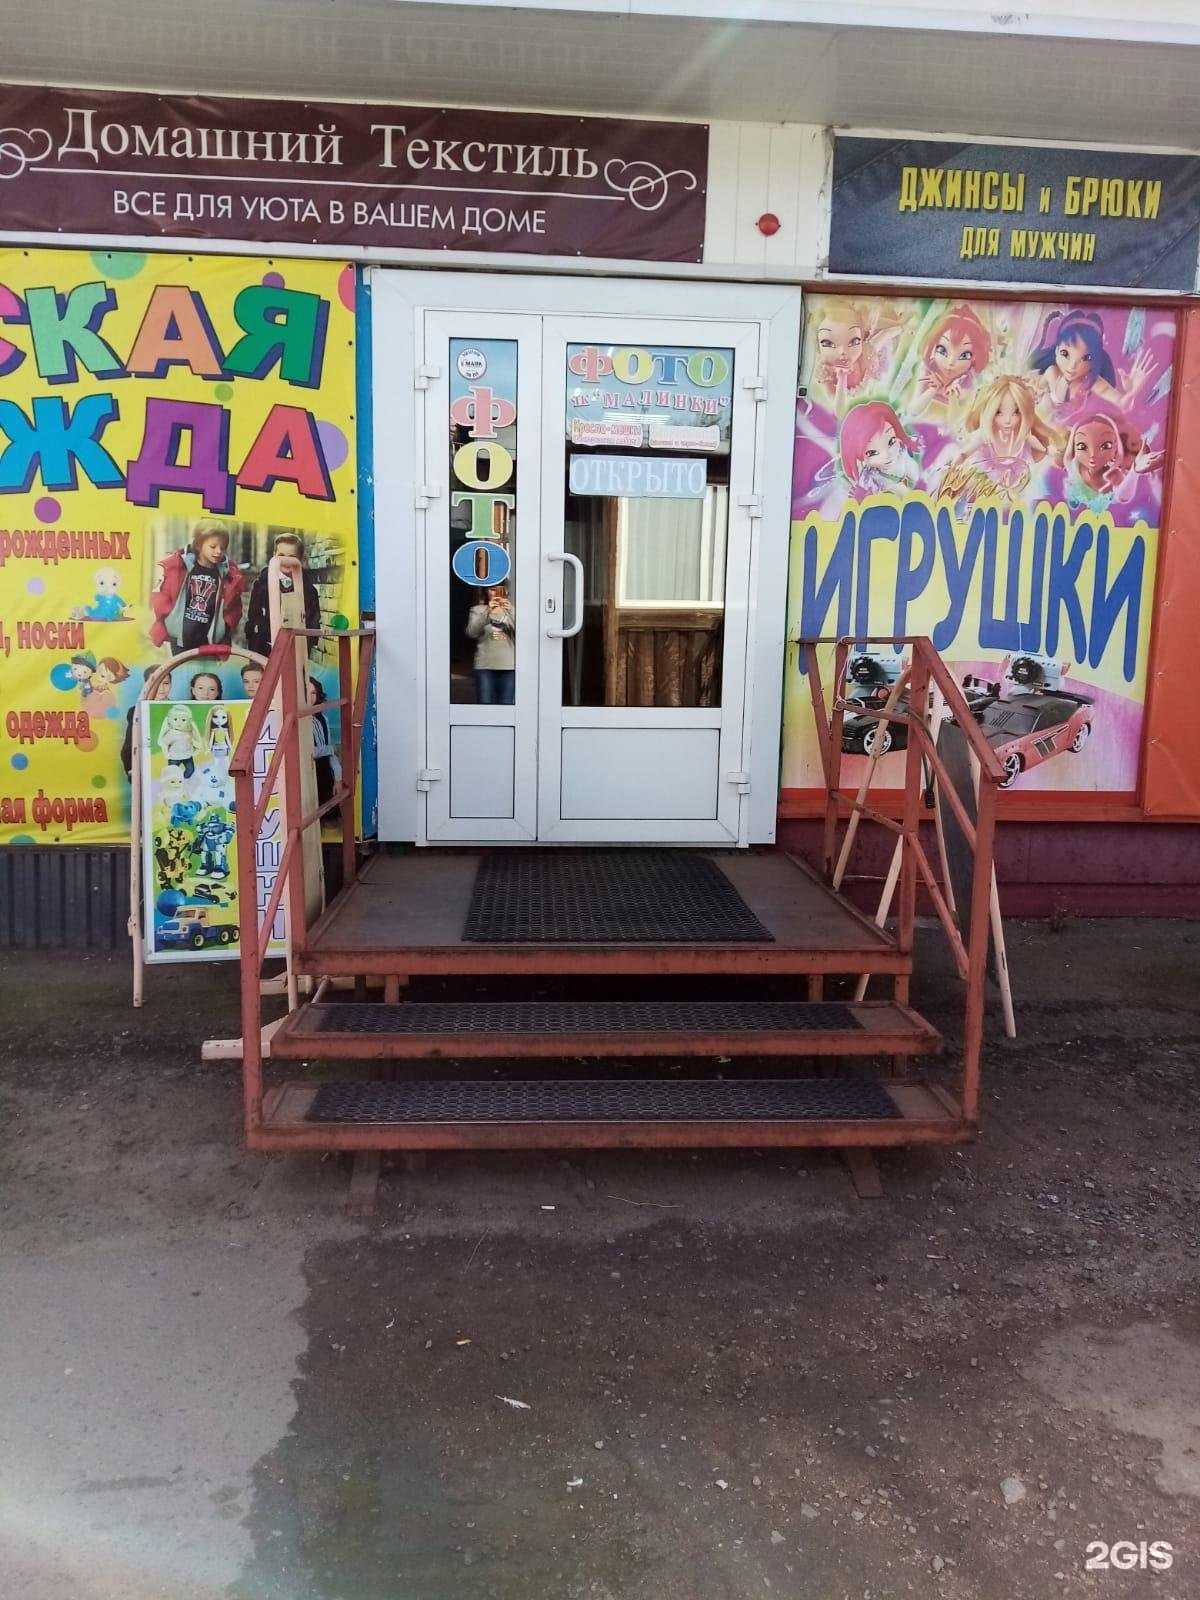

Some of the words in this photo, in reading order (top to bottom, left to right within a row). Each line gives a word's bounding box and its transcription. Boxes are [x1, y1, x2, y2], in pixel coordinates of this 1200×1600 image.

[58, 107, 344, 165] Домашний
[370, 124, 599, 179] Текстиль
[113, 190, 166, 216] ВСЕ
[173, 192, 232, 221] ДЛЯ
[240, 196, 322, 224] УЮТА
[329, 200, 345, 225] В
[353, 201, 455, 230] ВАШЕМ
[461, 206, 546, 235] ДОМЕ
[898, 166, 1025, 213] ДЖИНСЫ
[1064, 175, 1162, 220] БРЮКИ
[959, 226, 1000, 260] ДЛЯ
[1010, 229, 1096, 262] МУЖЧИН
[568, 345, 729, 388] ФОТО
[451, 385, 517, 587] ФОТО
[571, 458, 704, 495] ОТКРЫТО
[0, 529, 132, 567] рожденных
[798, 501, 1146, 684] ИГРУШКИ
[17, 621, 85, 650] носки
[6, 710, 92, 745] одежда
[32, 788, 109, 832] форма
